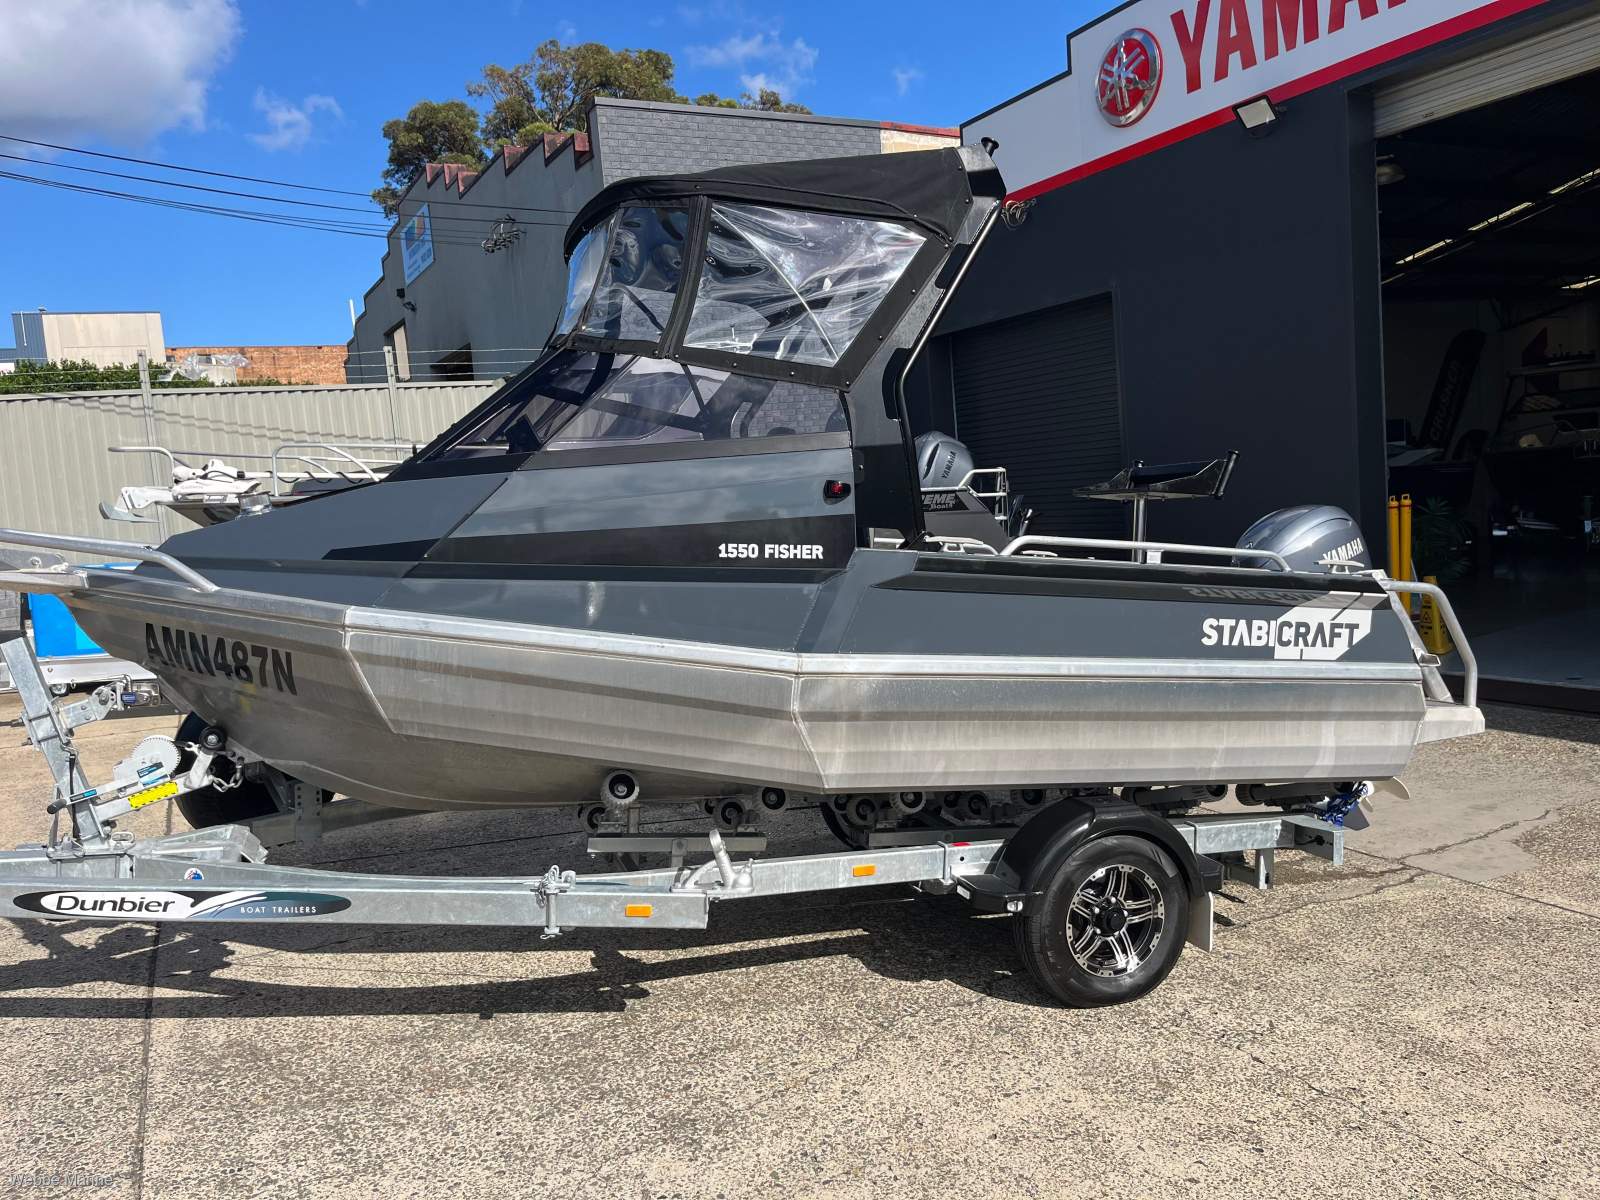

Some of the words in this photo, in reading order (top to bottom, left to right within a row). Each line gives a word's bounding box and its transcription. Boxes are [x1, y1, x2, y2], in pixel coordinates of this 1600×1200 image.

[941, 451, 957, 478] YAMAHA
[718, 543, 759, 558] 1550
[764, 544, 824, 559] FISHER
[1323, 537, 1364, 561] YAMAHA
[1201, 618, 1359, 648] STABICRAFT
[145, 622, 298, 696] AMN487N
[56, 895, 176, 913] Dunbier
[240, 906, 266, 914] BOAT
